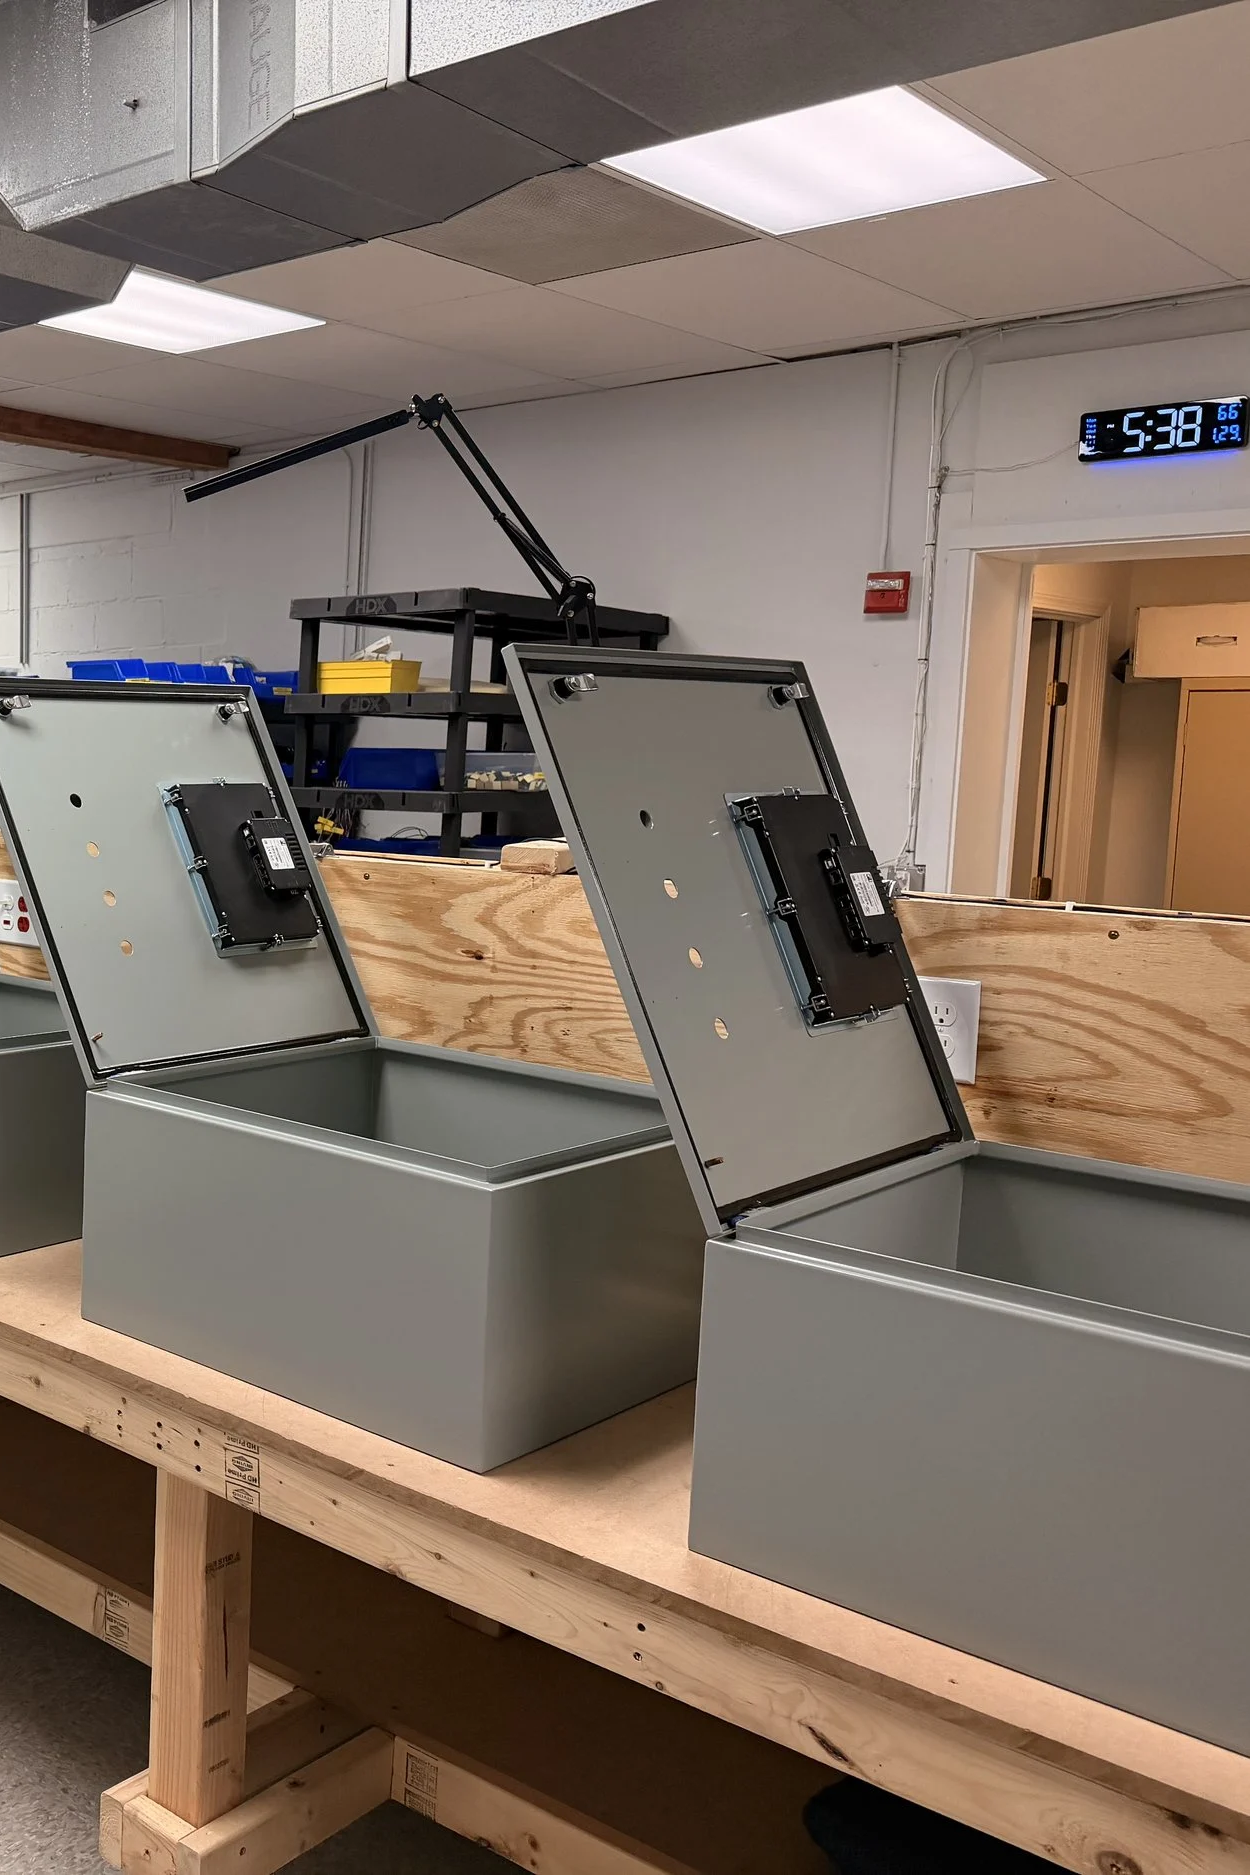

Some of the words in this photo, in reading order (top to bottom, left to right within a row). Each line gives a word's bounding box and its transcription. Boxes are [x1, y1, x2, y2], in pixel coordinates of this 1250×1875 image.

[249, 0, 271, 130] AUGE
[1123, 405, 1203, 453] 5:38
[355, 599, 387, 614] HDX
[350, 696, 380, 711] HDX
[345, 794, 374, 808] HDX
[247, 1474, 257, 1483] HD
